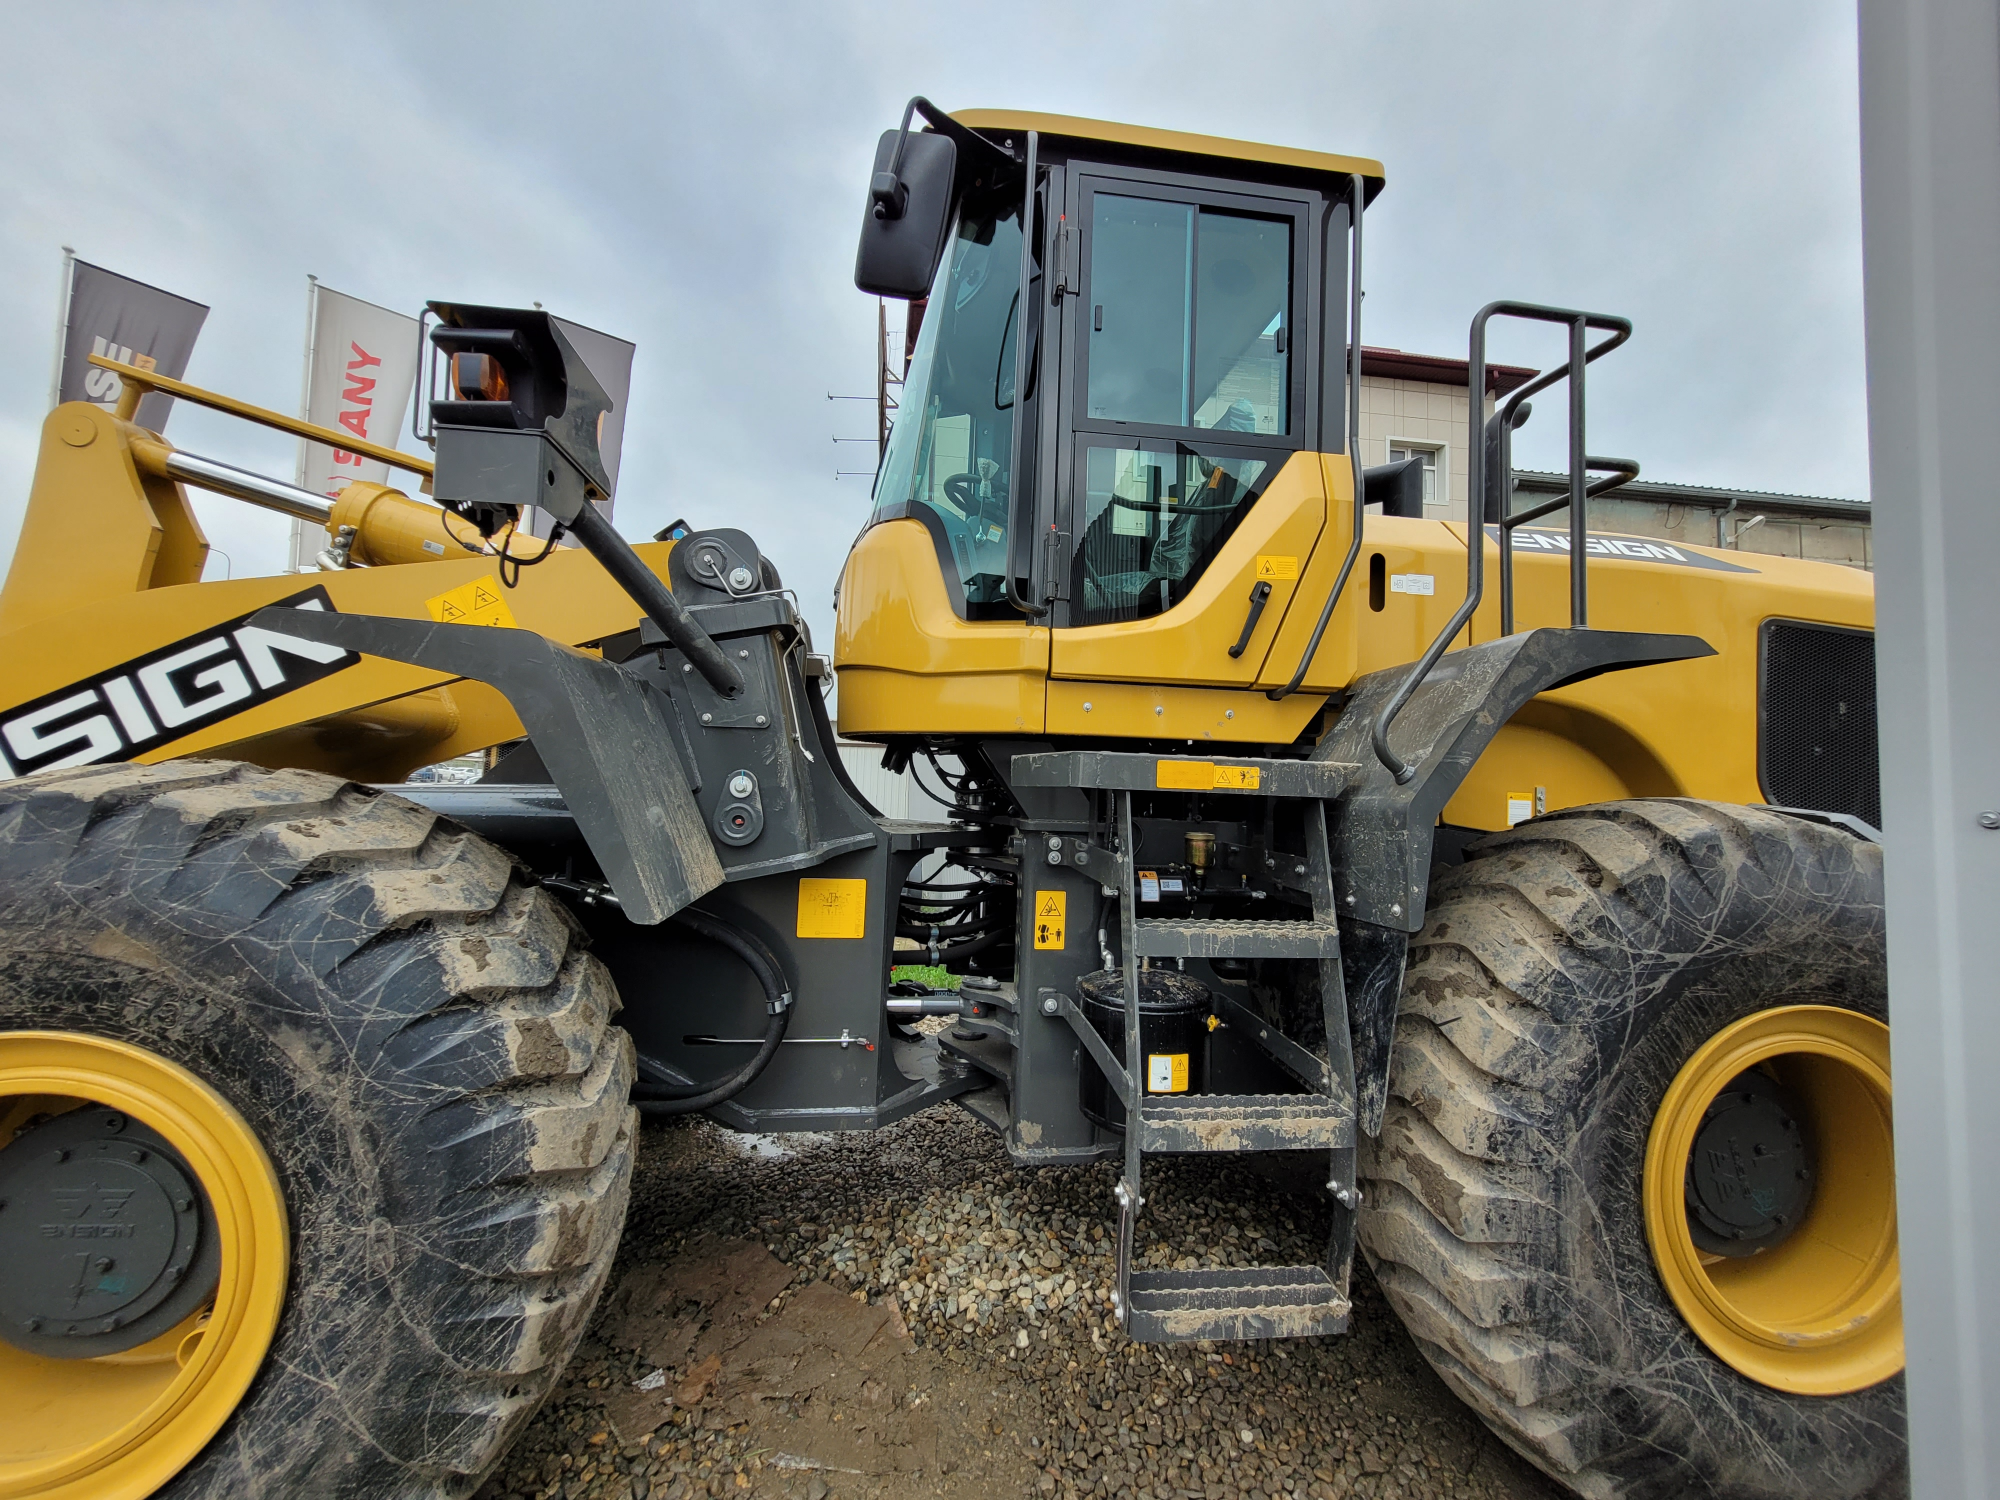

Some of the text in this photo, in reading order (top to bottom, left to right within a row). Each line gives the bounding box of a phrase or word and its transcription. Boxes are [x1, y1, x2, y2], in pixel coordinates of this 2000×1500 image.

[84, 335, 133, 413] SE
[1497, 532, 1689, 562] ENSIGN
[0, 598, 347, 781] SIGN
